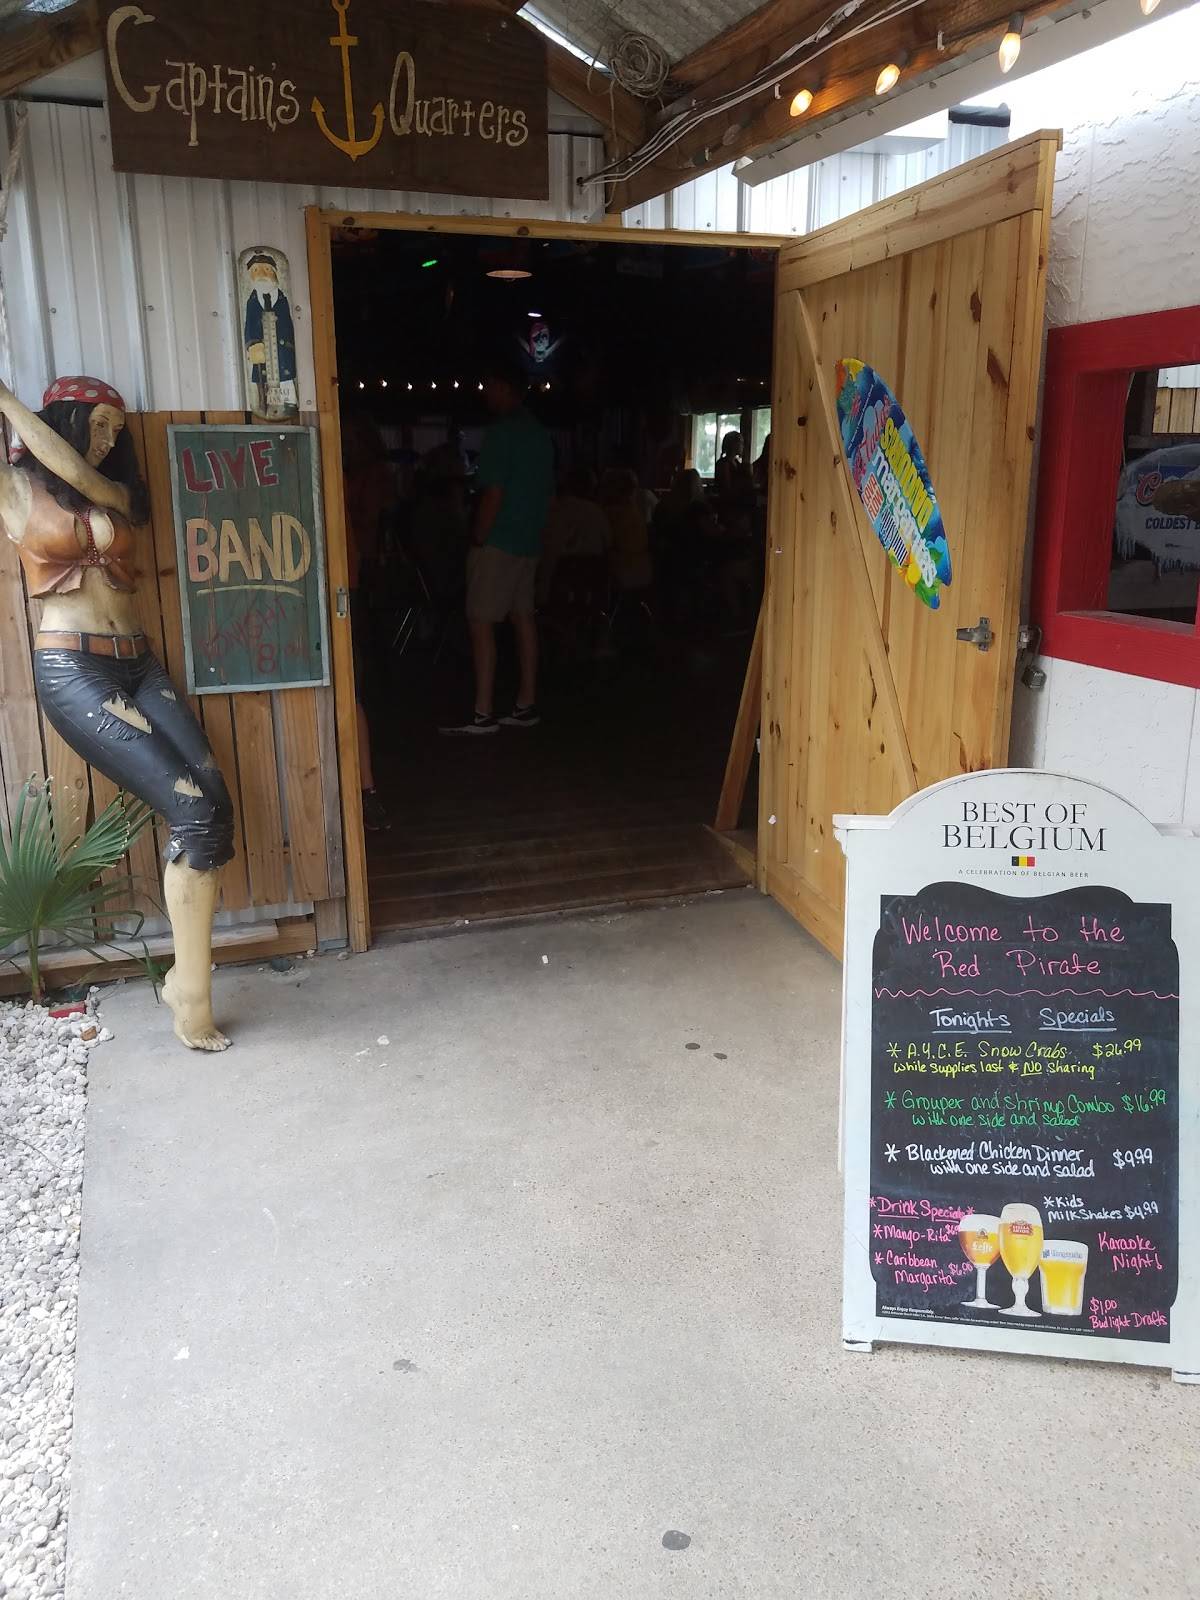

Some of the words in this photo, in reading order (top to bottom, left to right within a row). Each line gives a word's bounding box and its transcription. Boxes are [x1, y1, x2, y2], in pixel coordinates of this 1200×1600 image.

[106, 5, 300, 147] Captain's
[389, 51, 529, 147] Quarters
[182, 440, 280, 494] LIVE
[1145, 516, 1191, 530] COLDEST
[186, 512, 312, 583] BAND
[961, 801, 1036, 824] BEST
[1045, 803, 1088, 825] OF
[942, 824, 1108, 852] BELGIUM
[902, 913, 1002, 944] Welcome
[1023, 915, 1059, 943] to
[1080, 916, 1125, 942] the
[932, 949, 980, 978] Red
[1006, 949, 1101, 976] Pirate
[929, 1007, 1012, 1032] Tonights
[1039, 1006, 1115, 1030] Specials
[978, 1040, 1022, 1058] Snow
[1025, 1041, 1069, 1059] Crabs
[1092, 1038, 1142, 1059] $26.99
[980, 1059, 1004, 1073] last
[1021, 1060, 1042, 1076] NO
[902, 1089, 965, 1115] Grouper
[971, 1089, 1000, 1111] and
[1121, 1088, 1167, 1114] $16.99
[912, 1112, 947, 1126] with
[950, 1114, 974, 1126] one
[1010, 1112, 1037, 1125] and
[905, 1141, 975, 1161] Blackened
[979, 1141, 1032, 1160] Chicken
[1031, 1144, 1085, 1161] Dinner
[1113, 1148, 1153, 1169] $9.99
[930, 1160, 964, 1175] with
[965, 1162, 990, 1175] one
[992, 1162, 1021, 1176] side
[1022, 1161, 1050, 1177] and
[1053, 1159, 1095, 1178] salad
[877, 1196, 919, 1216] Drink
[1055, 1194, 1084, 1208] Kids
[1124, 1200, 1159, 1220] $4.99
[884, 1224, 951, 1249] Mango-Rita
[1098, 1231, 1156, 1252] Karaoke
[886, 1250, 938, 1268] Caribbean
[1113, 1253, 1163, 1275] Night!
[895, 1269, 957, 1292] Margarita
[1090, 1297, 1118, 1316] $1.00
[1131, 1311, 1168, 1328] Drafts
